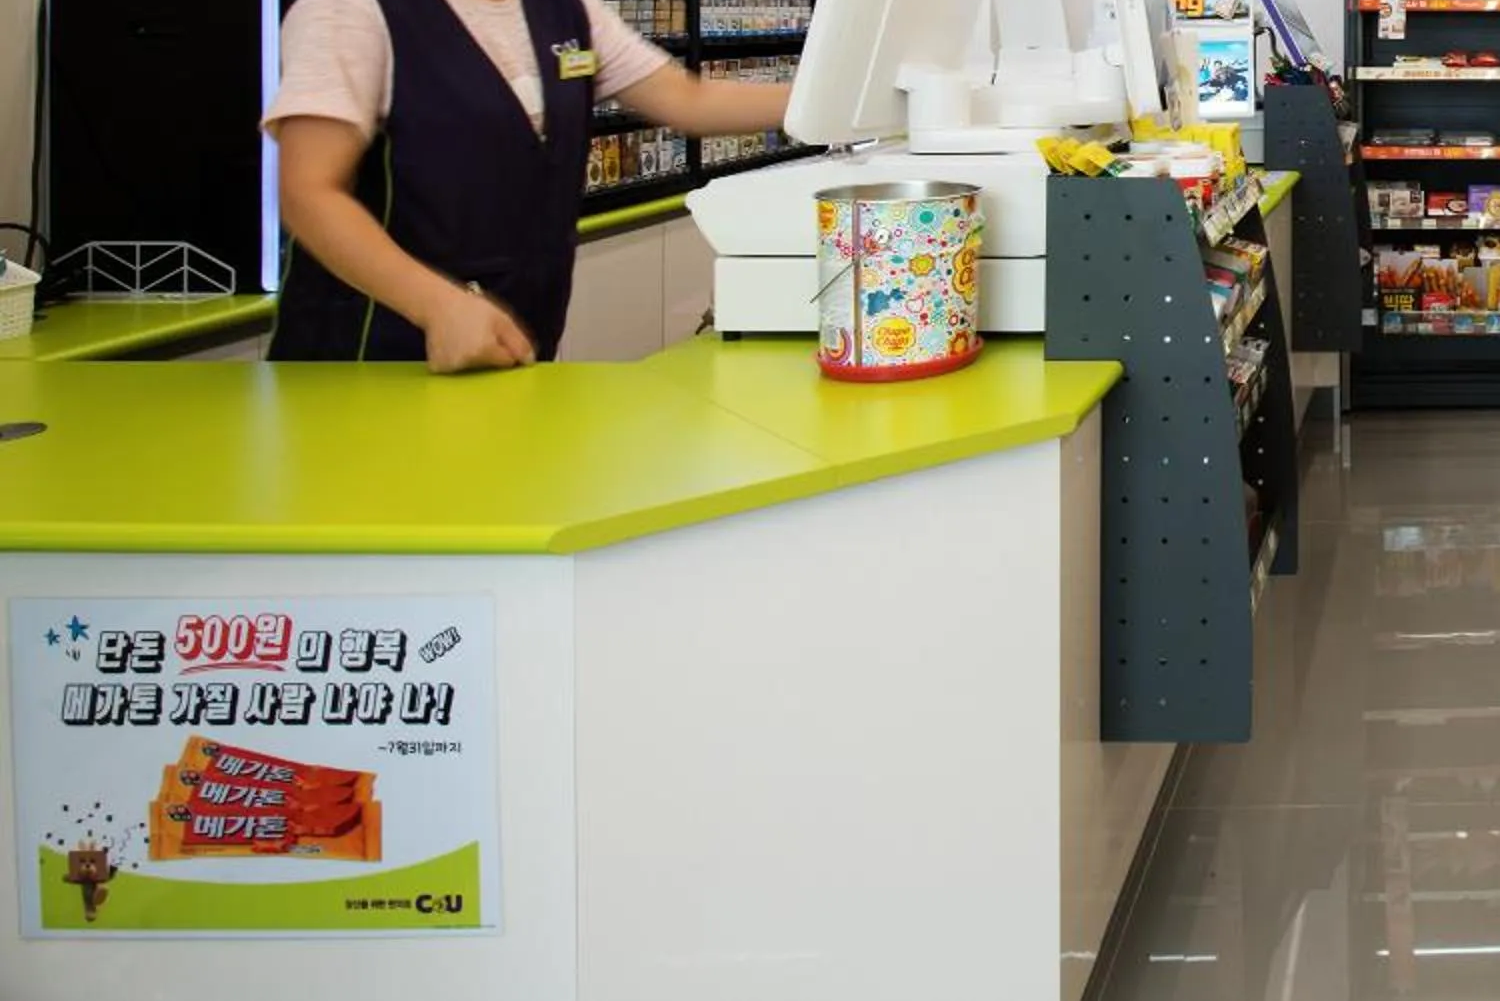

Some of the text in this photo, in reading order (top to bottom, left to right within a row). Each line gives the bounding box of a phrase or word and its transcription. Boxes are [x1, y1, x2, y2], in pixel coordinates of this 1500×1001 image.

[97, 613, 406, 671] 단돈 500원 의 행복
[419, 627, 462, 662] WOW!
[62, 683, 454, 725] 메가톤 가질 사람 나야 나!
[216, 753, 295, 784] 메가톤
[200, 780, 286, 808] 메가톤
[193, 815, 288, 840] 메가톤
